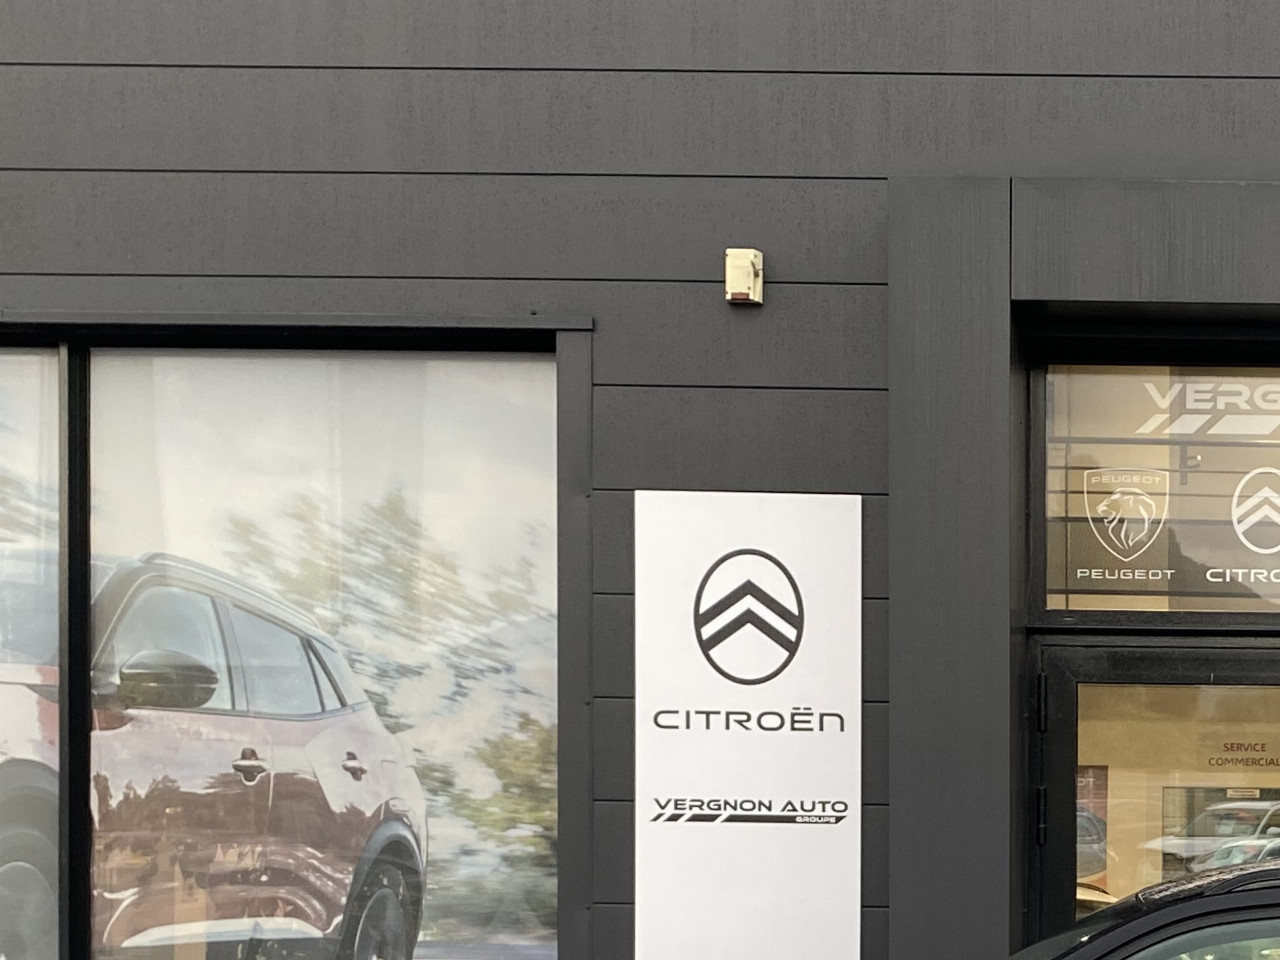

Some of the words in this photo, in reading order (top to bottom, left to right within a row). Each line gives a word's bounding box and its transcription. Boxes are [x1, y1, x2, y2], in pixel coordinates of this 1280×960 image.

[1091, 475, 1161, 486] PEUGEOT
[1077, 568, 1175, 580] PEUGEOT
[1223, 743, 1267, 752] SERVICE
[653, 797, 772, 812] VERGNON
[780, 800, 848, 813] AUTO
